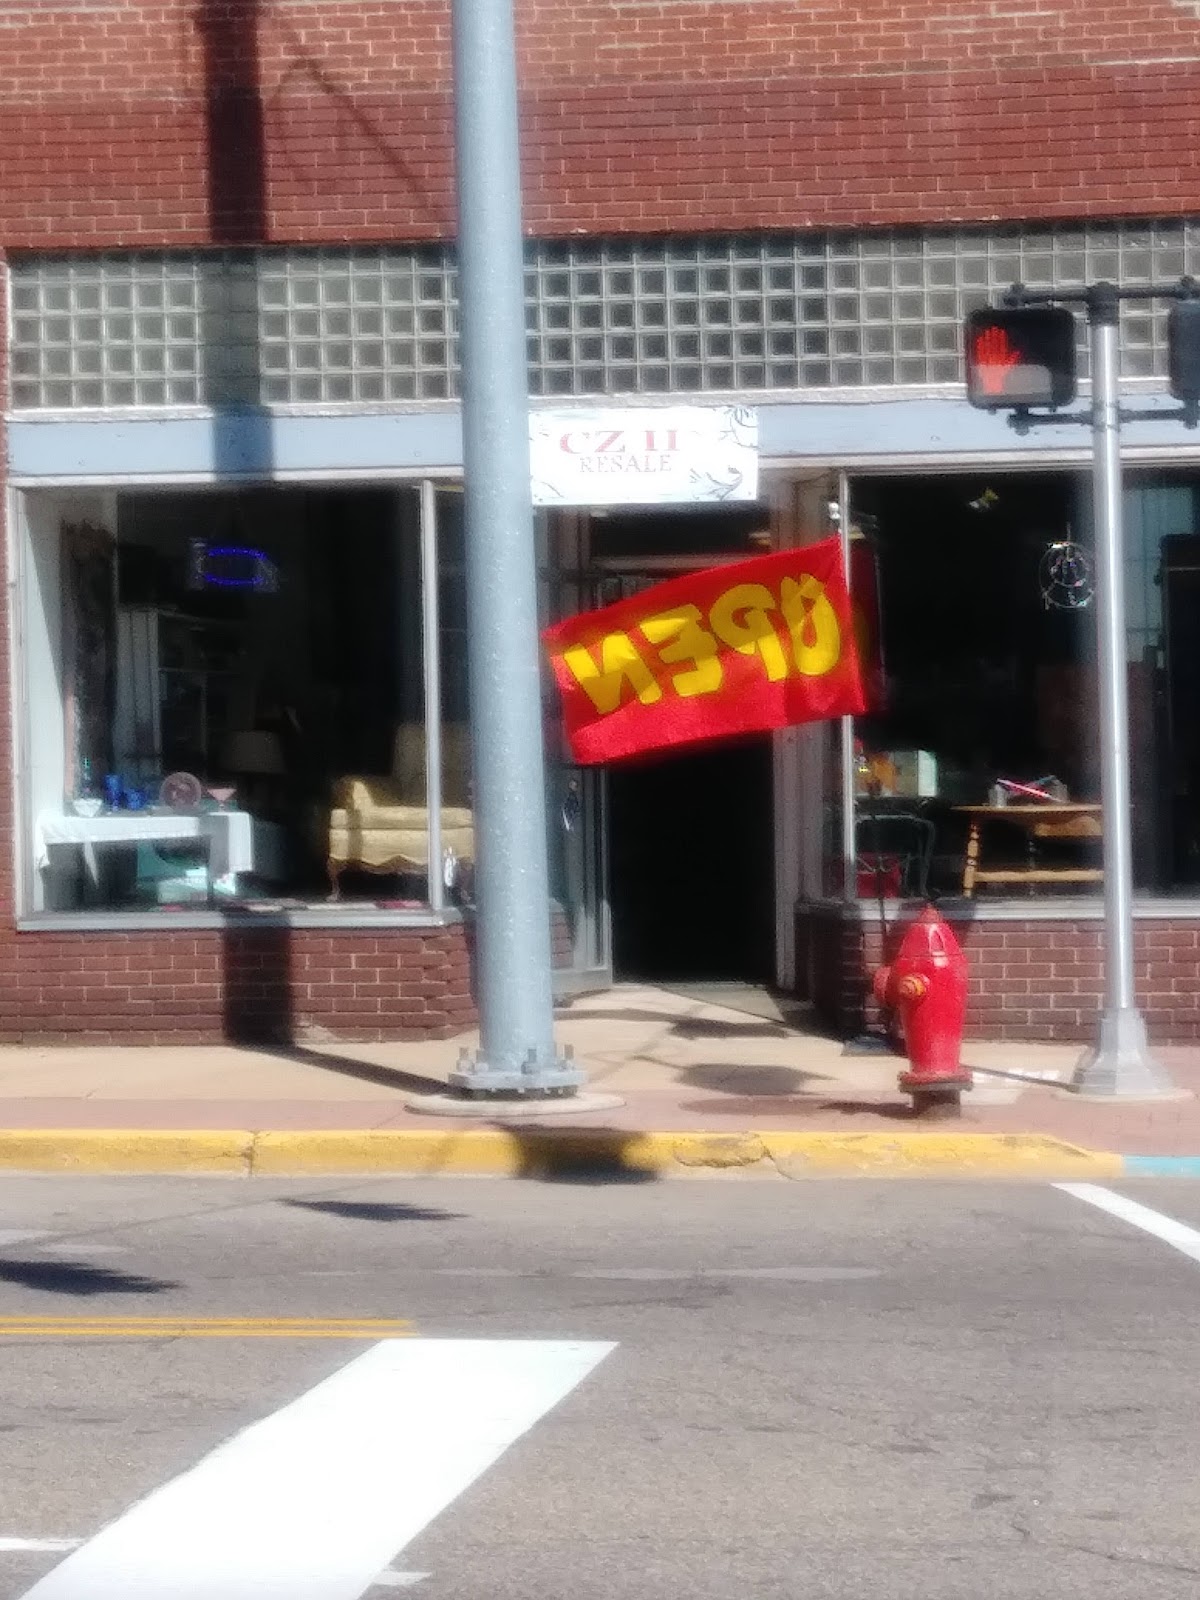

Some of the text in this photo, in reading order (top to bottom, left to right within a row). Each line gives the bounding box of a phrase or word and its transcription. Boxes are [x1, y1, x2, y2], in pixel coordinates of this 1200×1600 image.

[559, 429, 680, 454] CZ II
[579, 453, 673, 473] RESALE
